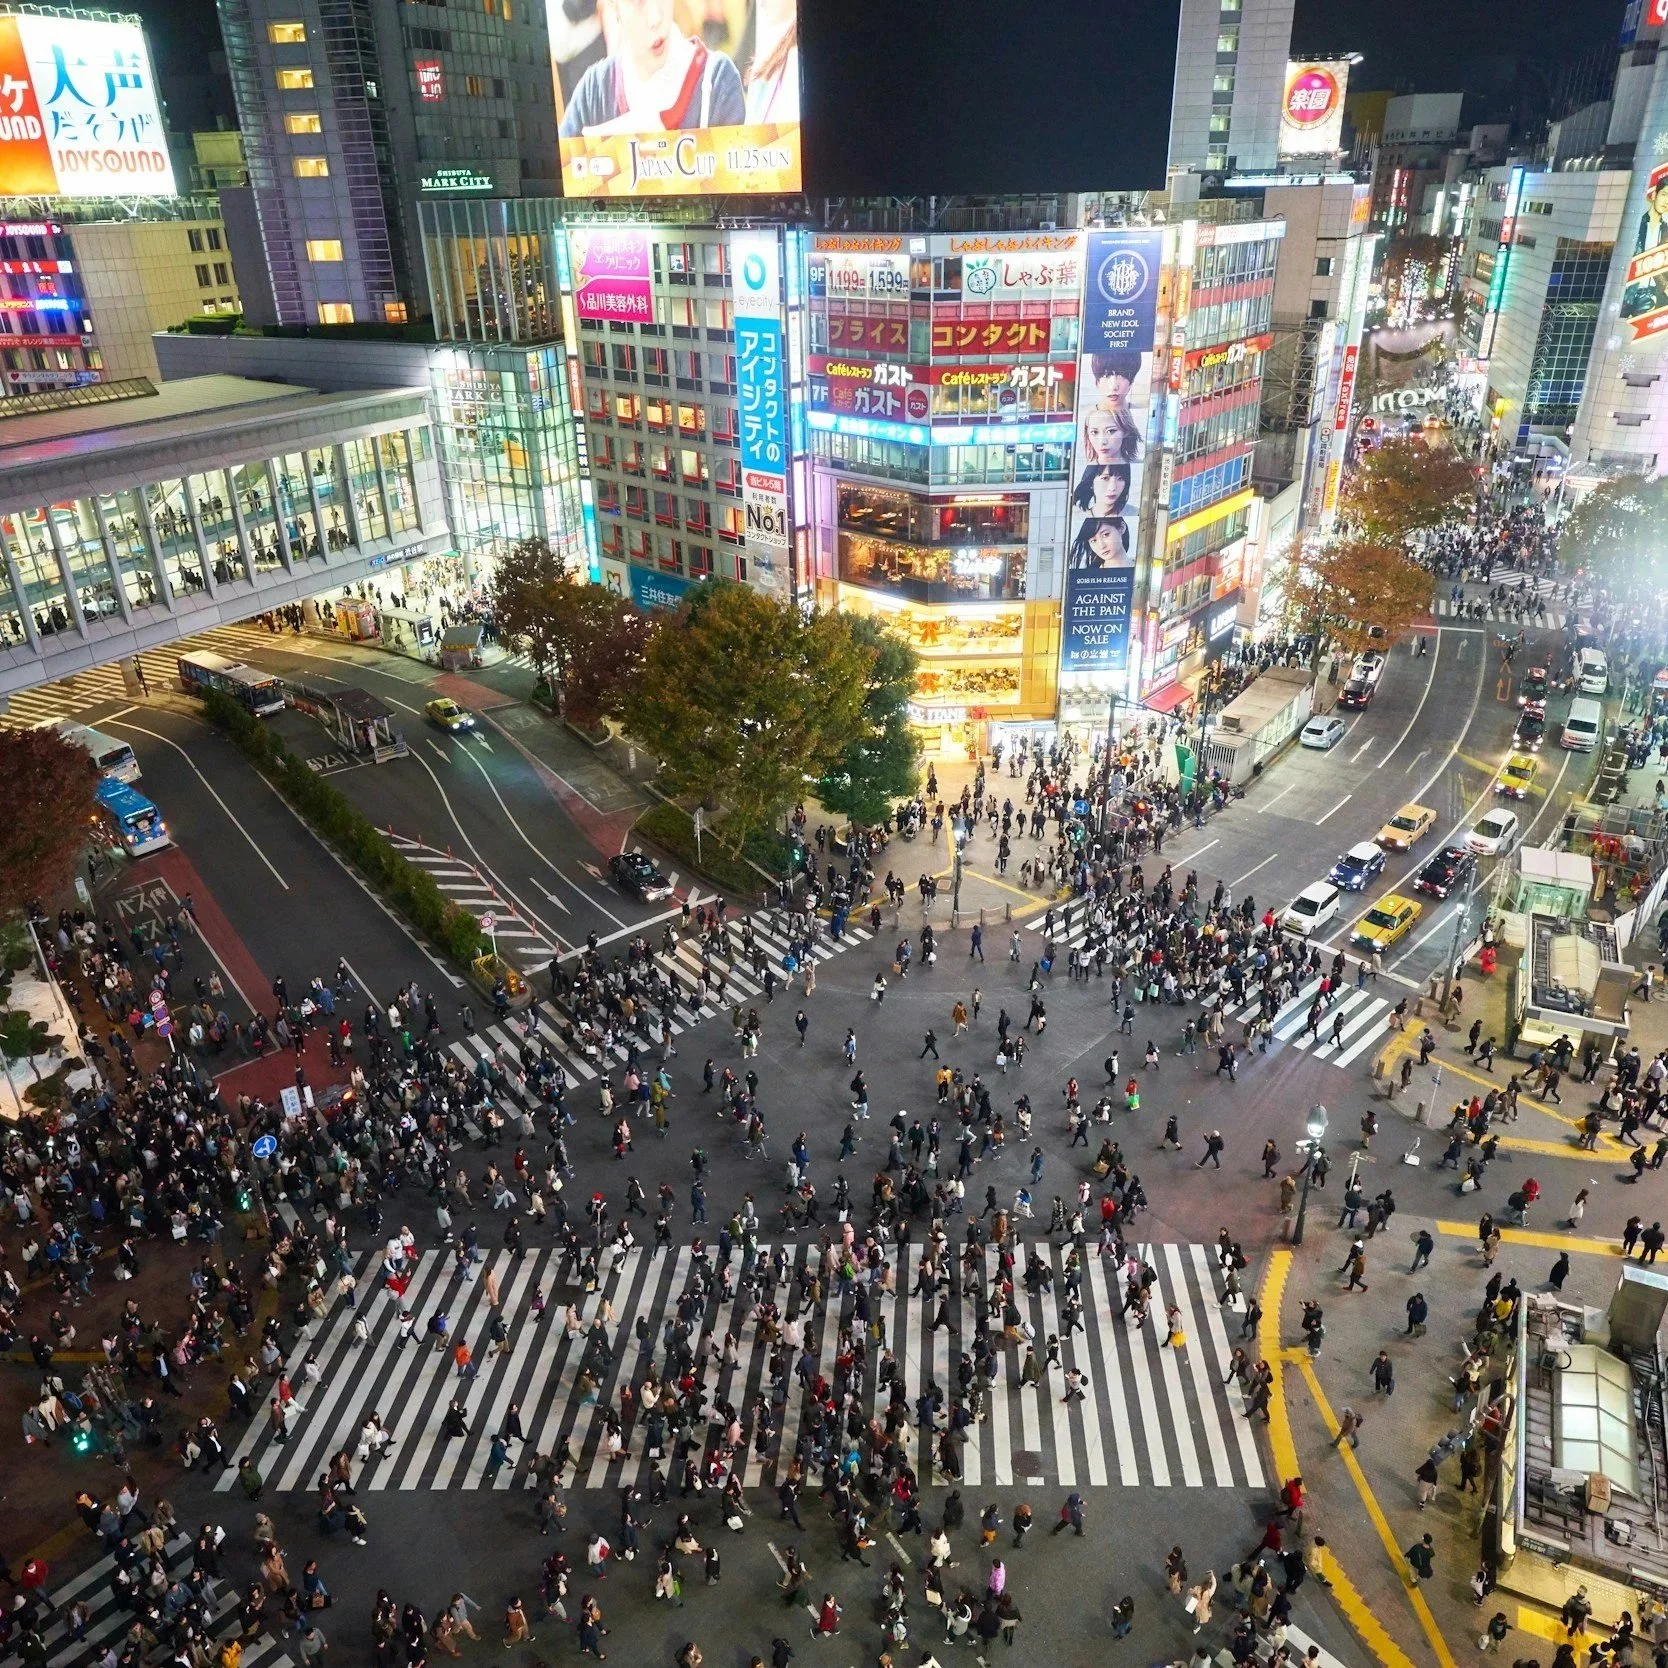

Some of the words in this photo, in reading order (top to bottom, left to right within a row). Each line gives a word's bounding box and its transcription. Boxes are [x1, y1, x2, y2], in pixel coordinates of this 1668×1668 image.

[36, 44, 143, 108] 大声
[0, 74, 28, 113] ケ
[1289, 88, 1331, 110] 楽園
[49, 111, 155, 144] だそうぜ
[57, 149, 166, 174] JOYSOUND
[629, 141, 673, 190] JAPAN
[676, 137, 716, 177] CUP
[421, 177, 458, 188] MARK
[460, 176, 491, 187] CITY
[437, 169, 472, 177] SHIBUYA
[6, 224, 48, 236] JOYSOUND
[814, 236, 903, 252] しゃぶしゃぶバイキング
[950, 235, 1078, 253] しゃぶしゃぶバイキング
[602, 255, 641, 270] クリニック
[810, 267, 825, 282] 9F
[1004, 260, 1077, 287] しゃぶ葉
[587, 292, 649, 315] 品川美容外科
[739, 295, 773, 310] eyecity
[1108, 308, 1134, 317] BRAND
[829, 319, 907, 346] プライス
[1101, 320, 1120, 328] NEW
[1121, 319, 1139, 328] IDOL
[933, 322, 1047, 348] コンタクト
[1104, 329, 1135, 338] SOCIETY
[1109, 339, 1129, 348] FIRST
[826, 362, 873, 379] Caféレストラン
[873, 363, 913, 387] ガスト
[941, 370, 1007, 386] Caféレストラン
[1009, 365, 1064, 388] ガスト
[740, 331, 763, 461] アイシティ
[761, 332, 780, 463] コンタクトの
[812, 384, 829, 402] 7F
[832, 387, 853, 400] Café
[854, 386, 901, 416] ガスト
[910, 401, 927, 411] ガスト
[745, 501, 785, 537] No.1
[746, 530, 786, 546] コンタクトショップ
[1103, 576, 1127, 584] RELEASE
[1072, 606, 1096, 617] THE
[1072, 624, 1102, 635] NOW
[1103, 623, 1123, 634] ON
[1084, 634, 1109, 645] SALE
[114, 886, 169, 915] バス停
